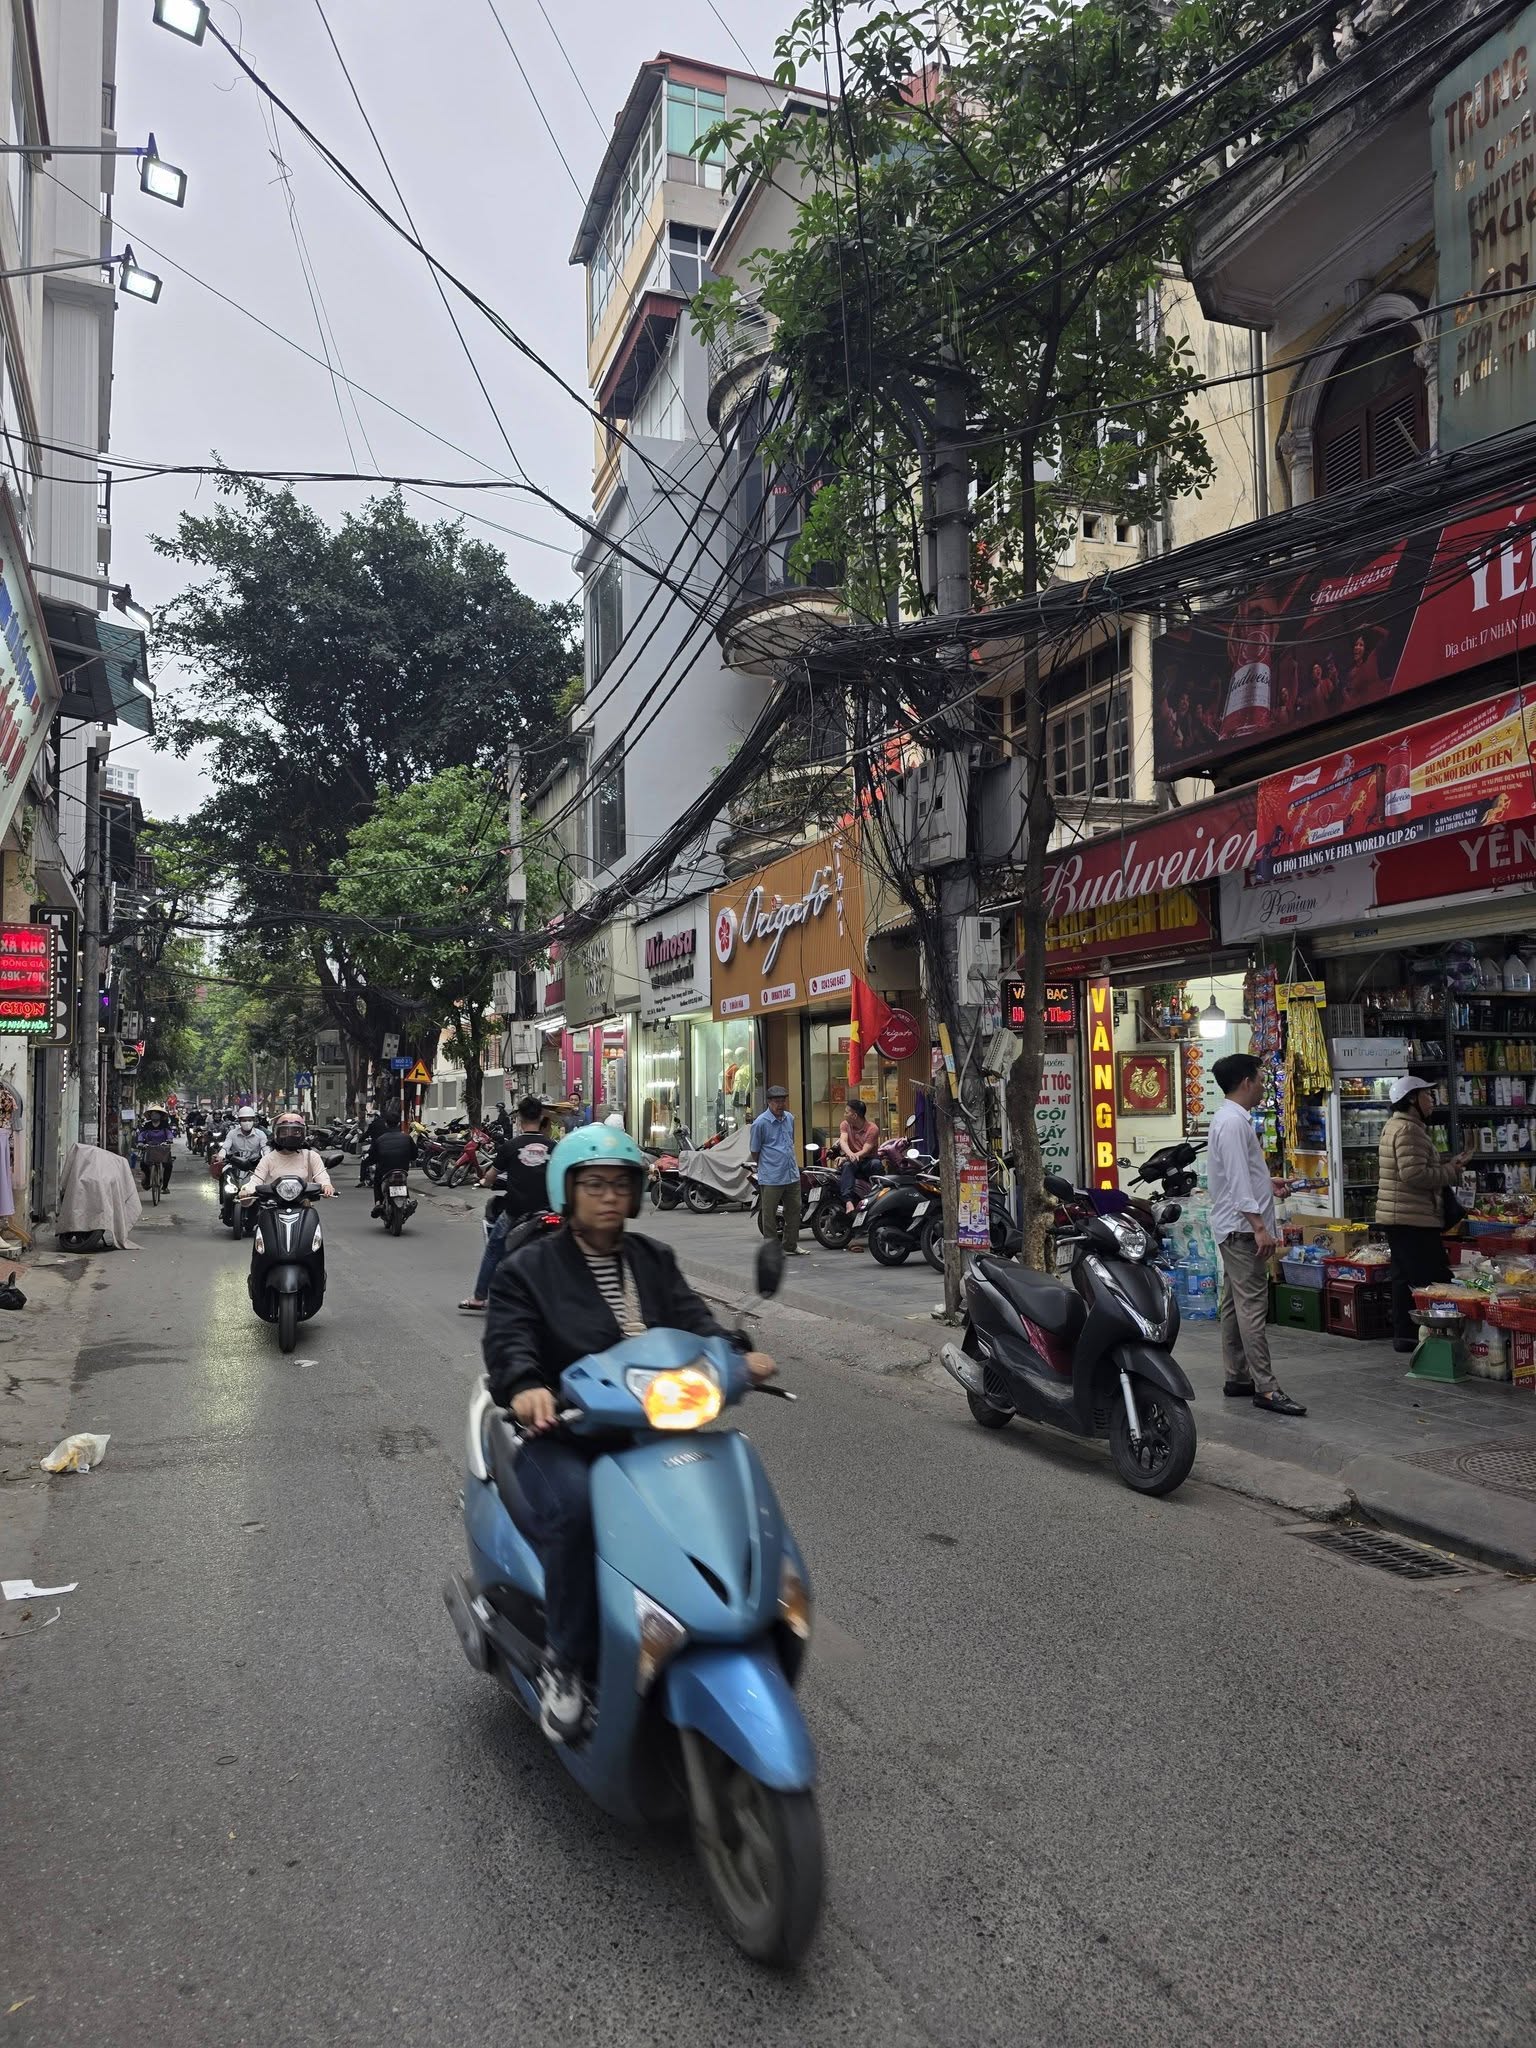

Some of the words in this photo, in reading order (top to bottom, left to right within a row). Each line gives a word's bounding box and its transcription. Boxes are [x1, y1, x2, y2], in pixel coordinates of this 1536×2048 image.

[1445, 46, 1528, 153] TRUNG
[1310, 560, 1399, 605] Budweiser
[1445, 643, 1459, 658] Địa
[1480, 629, 1489, 646] 17
[1490, 618, 1518, 642] NHÂN
[1521, 609, 1536, 630] HÒ
[1293, 773, 1321, 788] Budweiser
[1311, 827, 1341, 842] Budweiser
[1283, 858, 1297, 874] HỘI
[1337, 843, 1353, 859] FIFA
[1355, 835, 1385, 856] WORLD
[1386, 829, 1402, 846] CUP
[1042, 827, 1257, 918] Budweiser
[1259, 889, 1318, 924] Premium
[1279, 914, 1298, 925] BEER
[21, 940, 46, 955] KHO
[645, 929, 696, 970] Mimosa
[1046, 988, 1068, 1002] BẠC
[0, 1001, 46, 1019] CHỌN
[7, 1018, 30, 1030] NHÂN
[1091, 987, 1114, 1129] VÀNG
[1051, 1071, 1071, 1090] TÓC
[1035, 1095, 1050, 1105] AM
[1058, 1093, 1071, 1104] NỮ
[1036, 1107, 1066, 1123] GỘI
